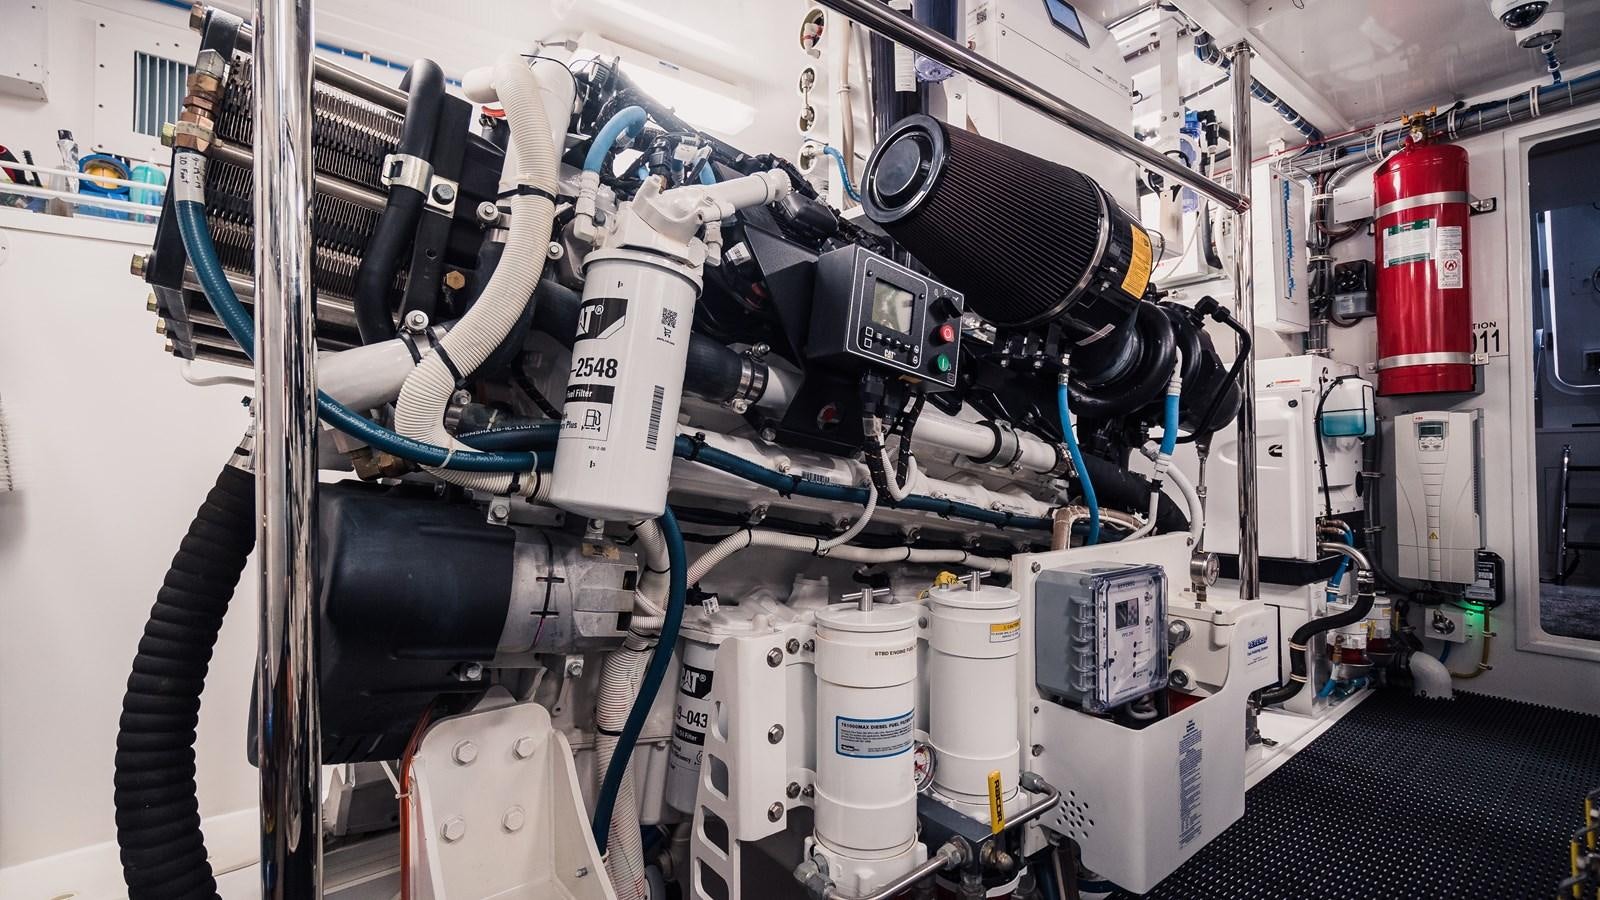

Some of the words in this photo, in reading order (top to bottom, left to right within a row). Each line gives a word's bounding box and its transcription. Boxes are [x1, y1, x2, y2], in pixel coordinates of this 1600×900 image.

[1472, 321, 1497, 329] TION
[570, 357, 619, 379] -2548
[575, 388, 593, 398] Filter
